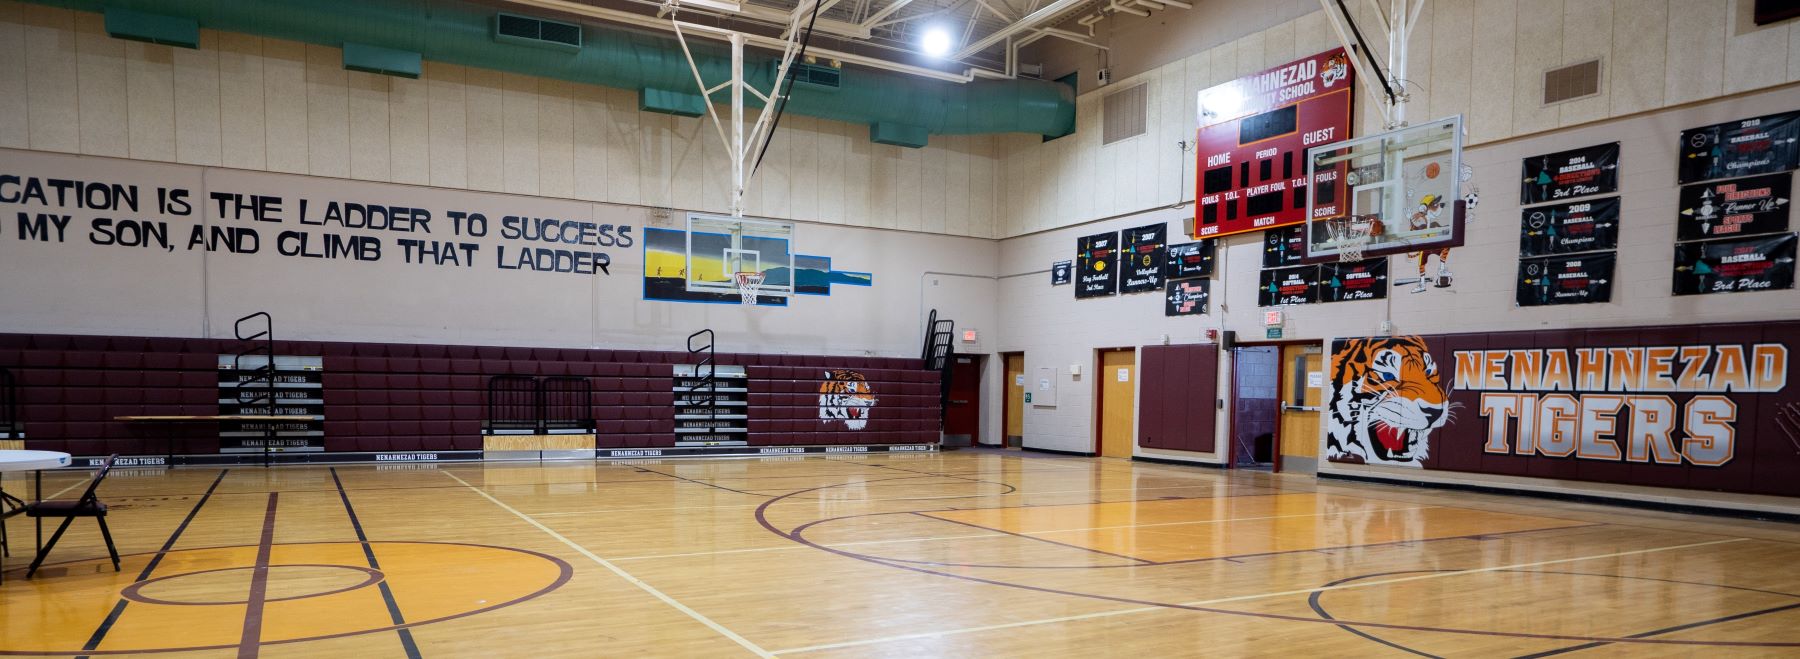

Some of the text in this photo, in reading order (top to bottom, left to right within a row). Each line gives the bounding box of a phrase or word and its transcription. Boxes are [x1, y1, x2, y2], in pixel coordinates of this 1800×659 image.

[1279, 81, 1316, 102] SCHOOL
[1303, 127, 1335, 146] GUEST
[1731, 132, 1770, 143] BASEBALL
[1207, 152, 1231, 167] HOME
[1255, 147, 1278, 160] PERIOD
[1559, 162, 1595, 173] BASEBALL
[1315, 171, 1337, 183] FOULS
[1201, 195, 1219, 206] FOULS
[1246, 185, 1269, 197] PLAYER
[1270, 181, 1287, 192] FOUL
[1553, 185, 1599, 198] 3rd Place
[1314, 206, 1336, 217] SCORE
[1568, 203, 1591, 214] 2009
[157, 187, 192, 216] IS
[210, 192, 282, 223] THE
[300, 199, 431, 233] LADDER
[447, 211, 487, 237] TO
[501, 215, 633, 248] SUCCESS
[1253, 216, 1275, 227] MATCH
[1201, 225, 1219, 236] SCORE
[17, 212, 610, 275] MY SON, AND CLIMB THAT LADDER
[1721, 253, 1766, 264] BASEBALL
[1712, 278, 1772, 291] 3rd Place
[1289, 295, 1306, 303] Place
[1355, 291, 1373, 299] Place
[1453, 343, 1789, 392] NENAHNEZAD
[1479, 392, 1738, 467] TIGERS
[139, 457, 165, 465] TIGERS
